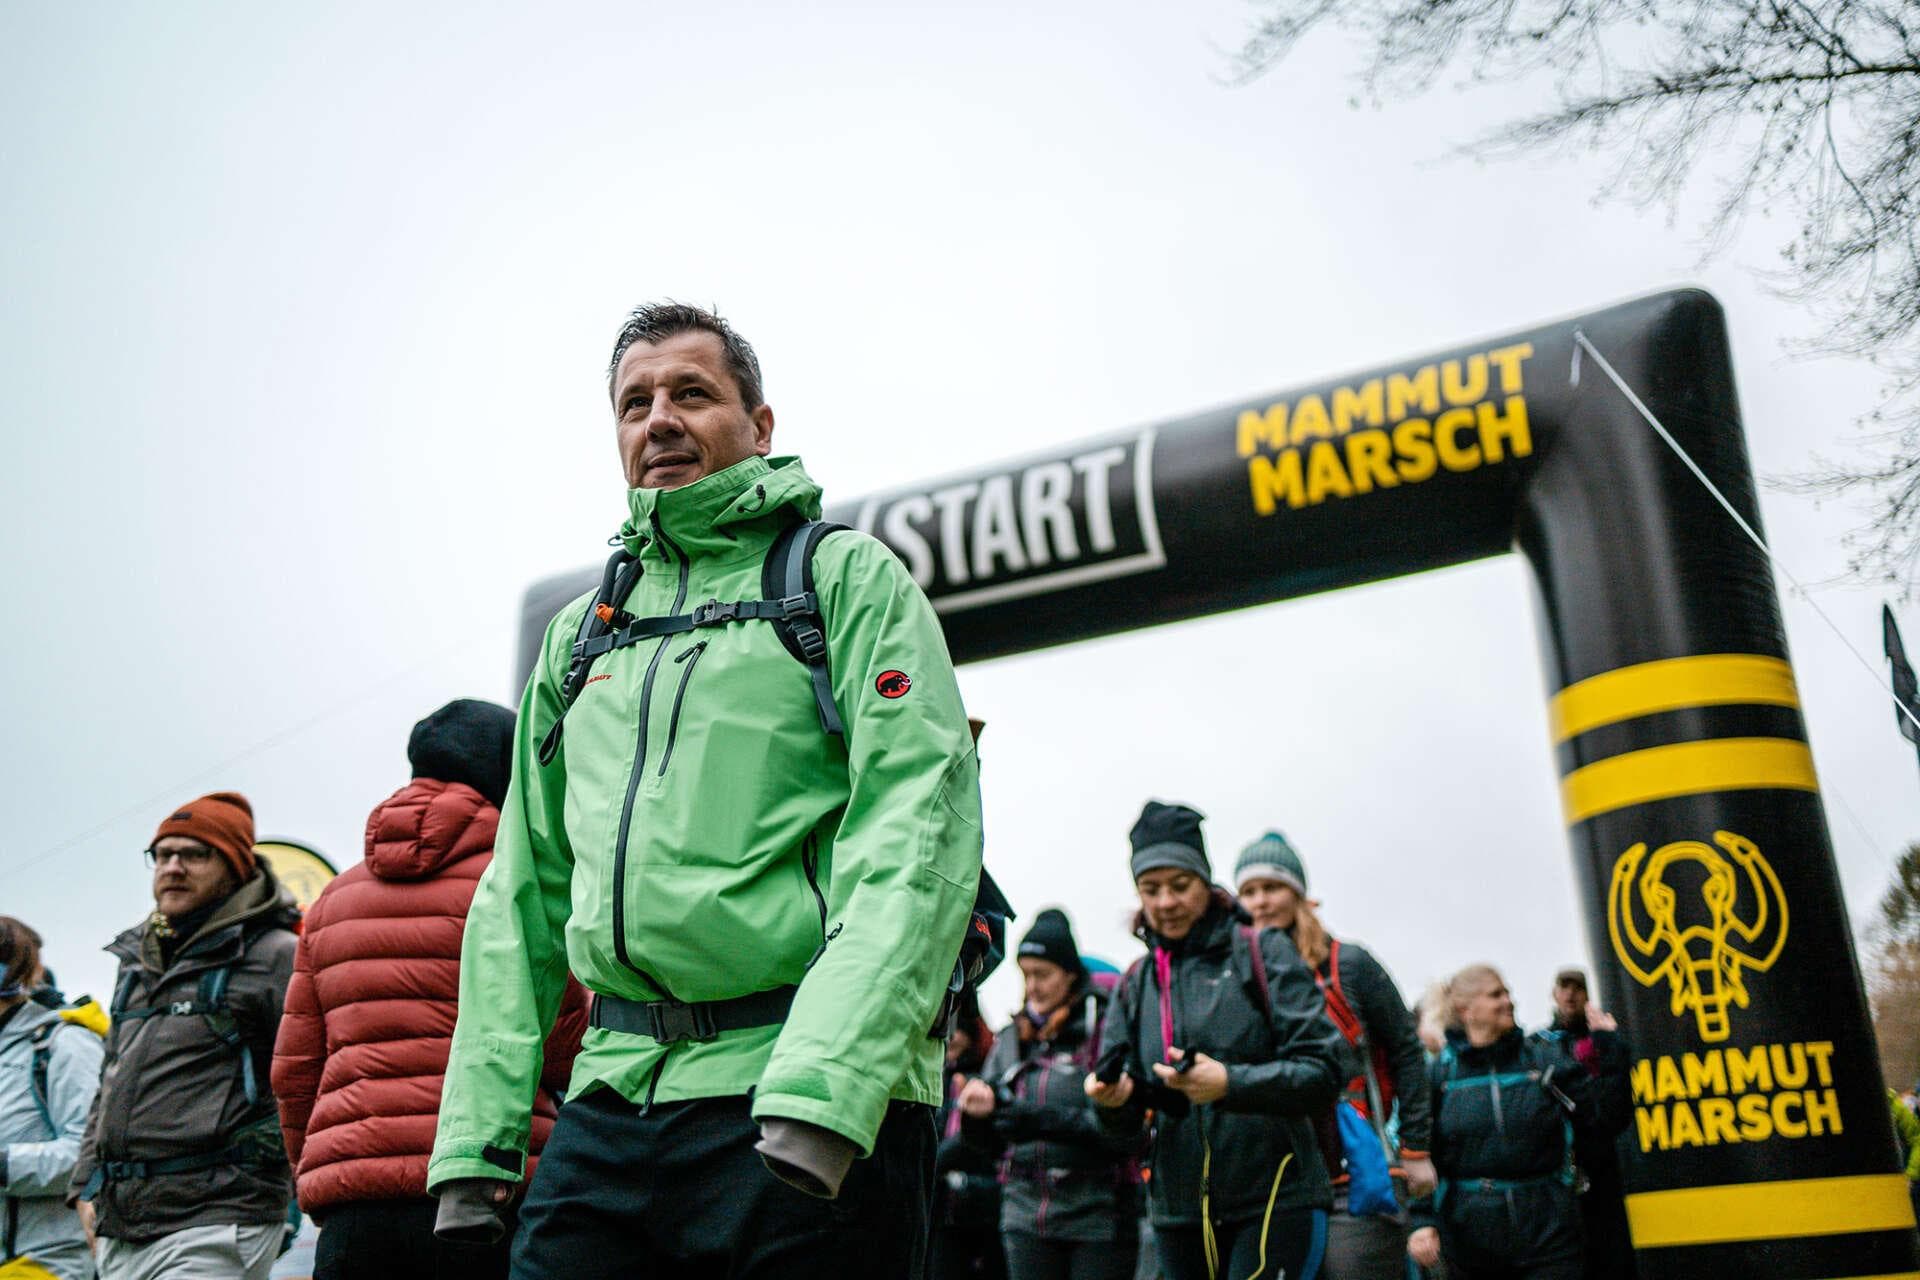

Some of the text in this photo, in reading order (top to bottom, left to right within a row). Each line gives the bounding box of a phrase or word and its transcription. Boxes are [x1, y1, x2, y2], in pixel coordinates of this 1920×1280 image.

[1235, 342, 1534, 459] MAMMUT
[1250, 395, 1533, 516] MARSCH
[883, 447, 1126, 592] START
[1630, 1040, 1834, 1105] MAMMUT
[1635, 1088, 1844, 1153] MARSCH
